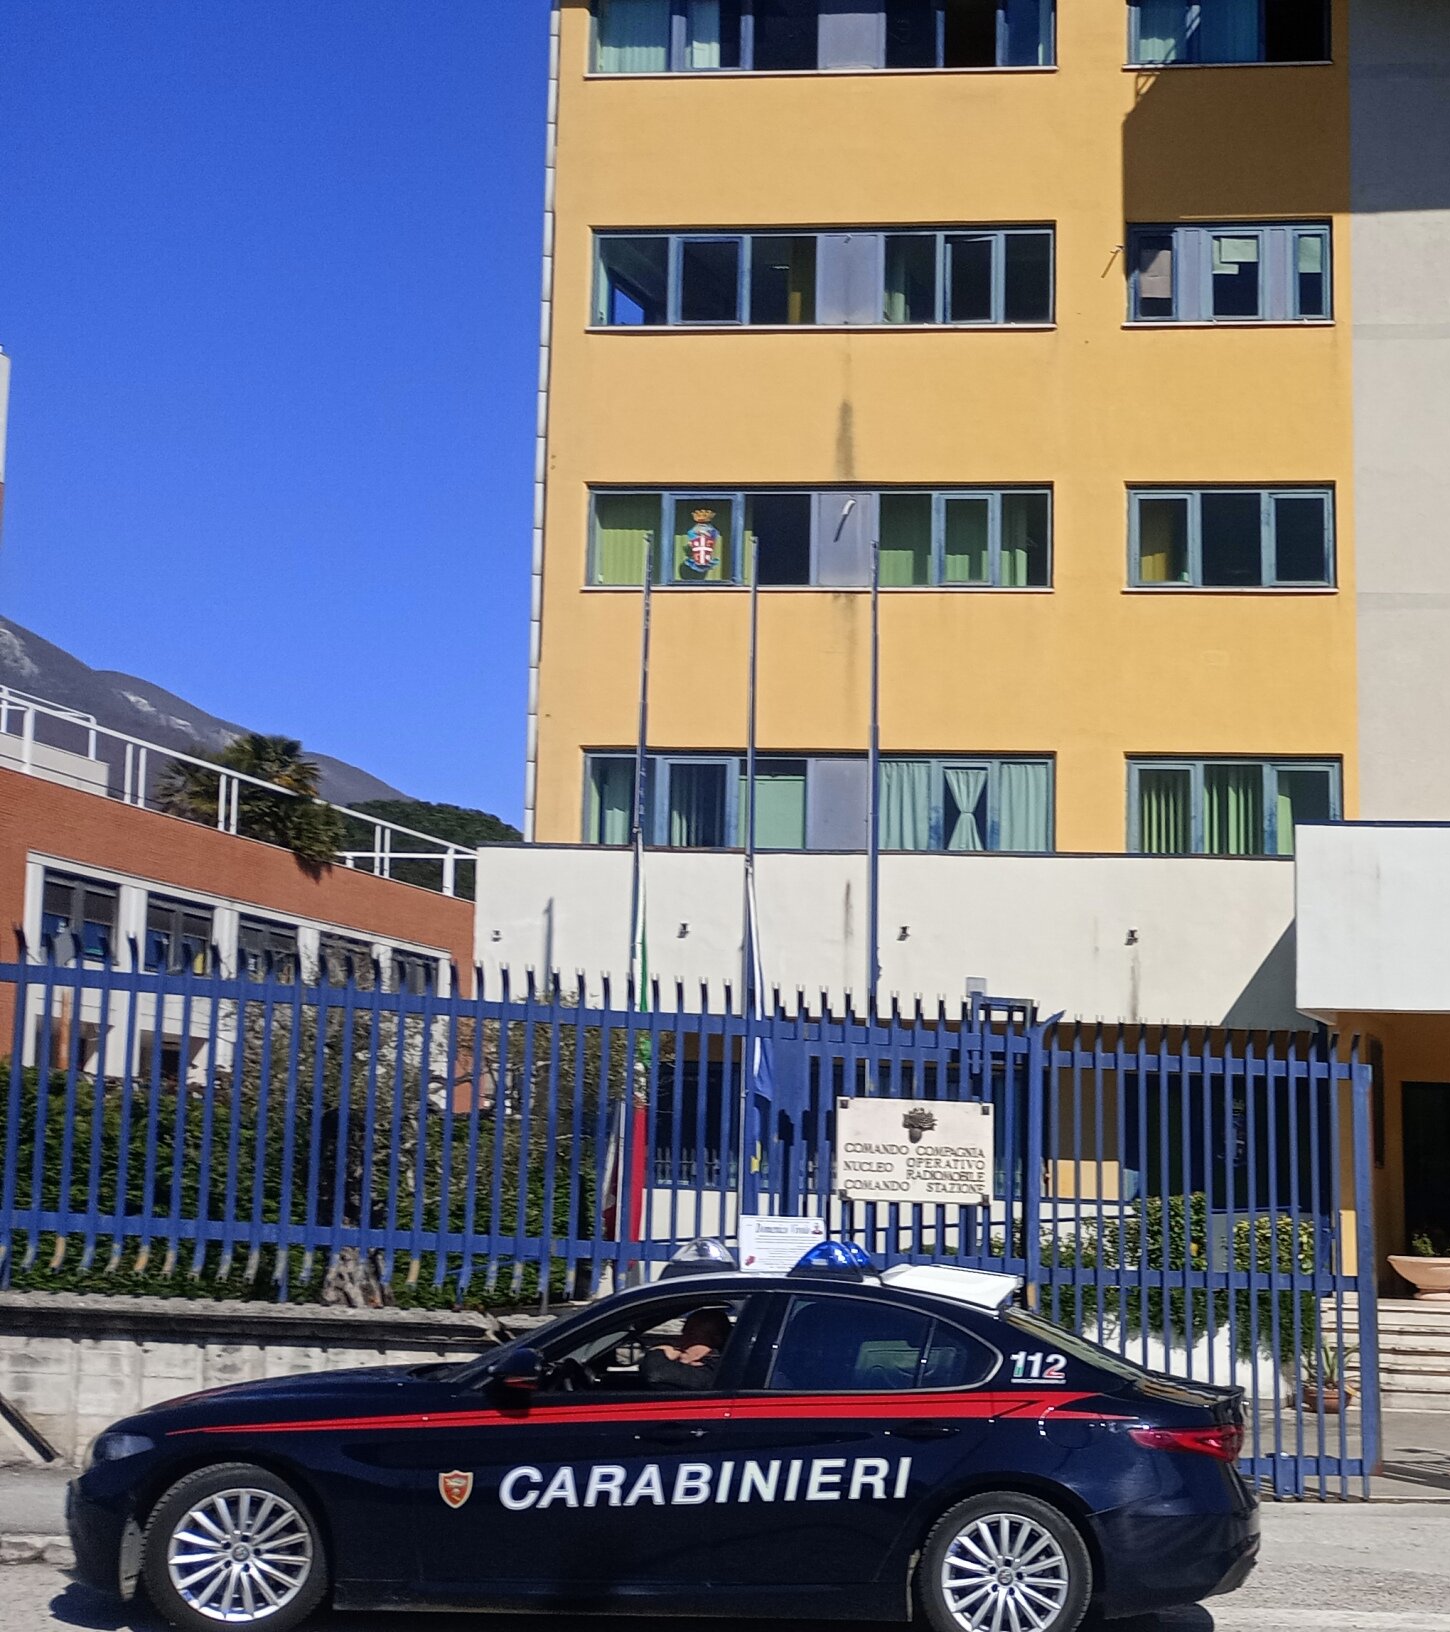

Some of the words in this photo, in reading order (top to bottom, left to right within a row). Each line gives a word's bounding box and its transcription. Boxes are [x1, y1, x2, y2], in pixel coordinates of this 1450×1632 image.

[844, 1142, 910, 1156] COMANDO
[915, 1145, 986, 1158] COMPAGNIA
[843, 1160, 894, 1172] NUCLEO
[905, 1157, 986, 1170] OPERATIVO
[905, 1169, 986, 1182] RADIOMOBILE
[843, 1178, 910, 1192] COMANDO
[925, 1181, 986, 1194] STAZIONE
[1010, 1350, 1068, 1379] 112
[499, 1456, 912, 1510] CARABINIERI
